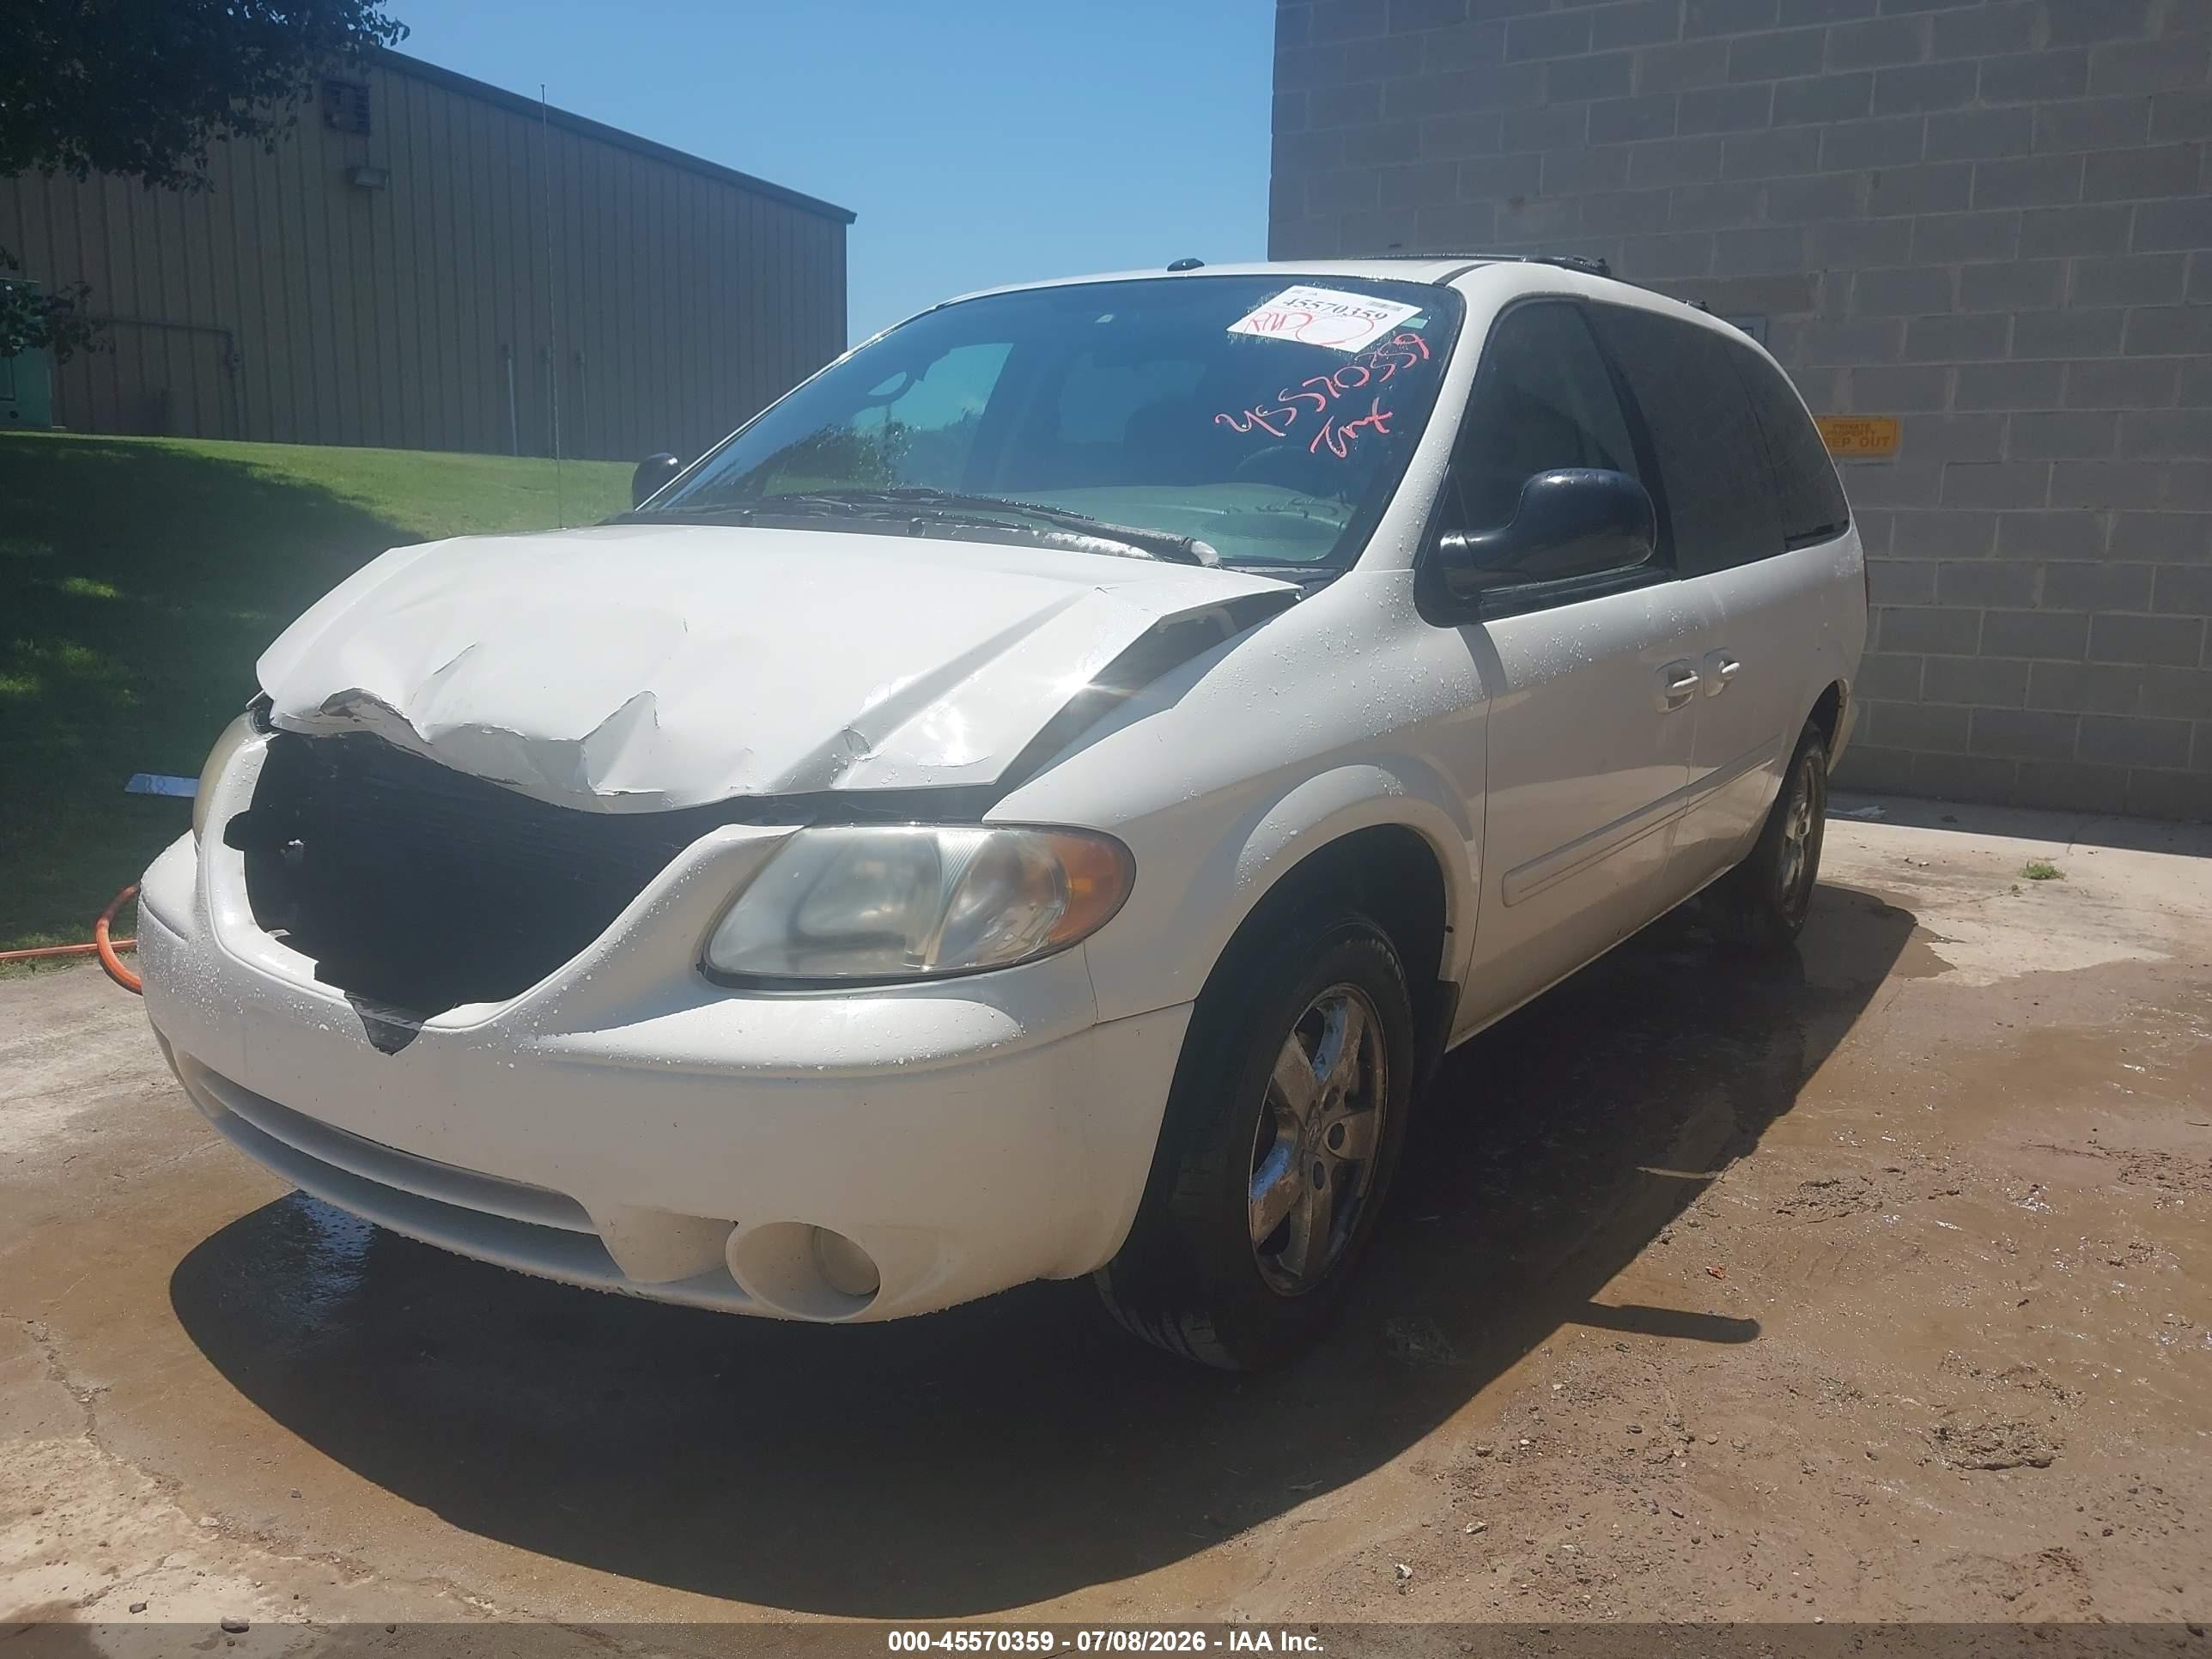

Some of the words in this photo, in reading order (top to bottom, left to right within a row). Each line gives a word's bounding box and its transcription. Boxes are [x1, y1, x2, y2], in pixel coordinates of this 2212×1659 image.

[1282, 297, 1389, 321] 45570359
[1214, 332, 1431, 438] 45570359
[1824, 437, 1852, 447] EEP
[1860, 437, 1891, 447] OUT
